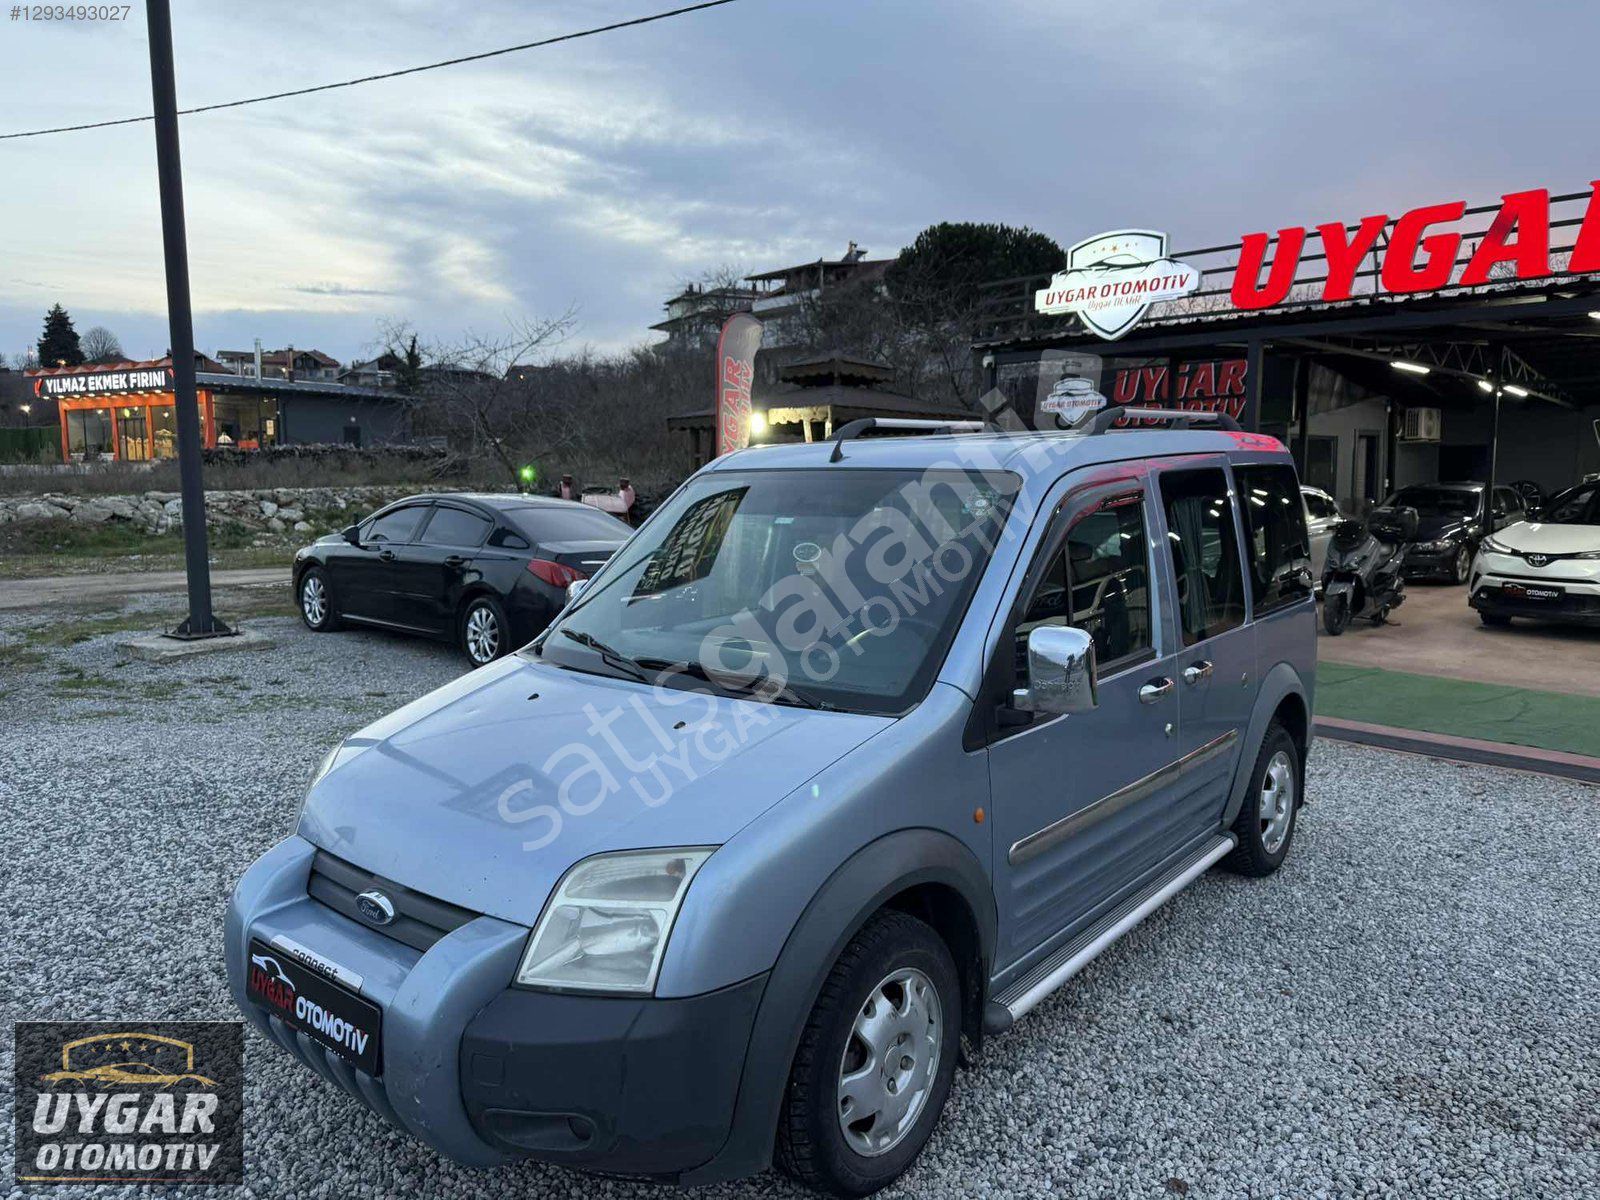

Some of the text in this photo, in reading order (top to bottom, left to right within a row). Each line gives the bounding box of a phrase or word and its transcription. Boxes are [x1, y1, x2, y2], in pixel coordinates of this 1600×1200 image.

[1045, 286, 1097, 306] UYGAR
[46, 370, 166, 393] YILMAZ EKMEK FIRINI
[1113, 360, 1248, 404] UYGAR
[722, 356, 742, 453] YGAR
[359, 899, 380, 920] Ford
[292, 948, 338, 980] connect
[251, 965, 296, 1013] UYGAR
